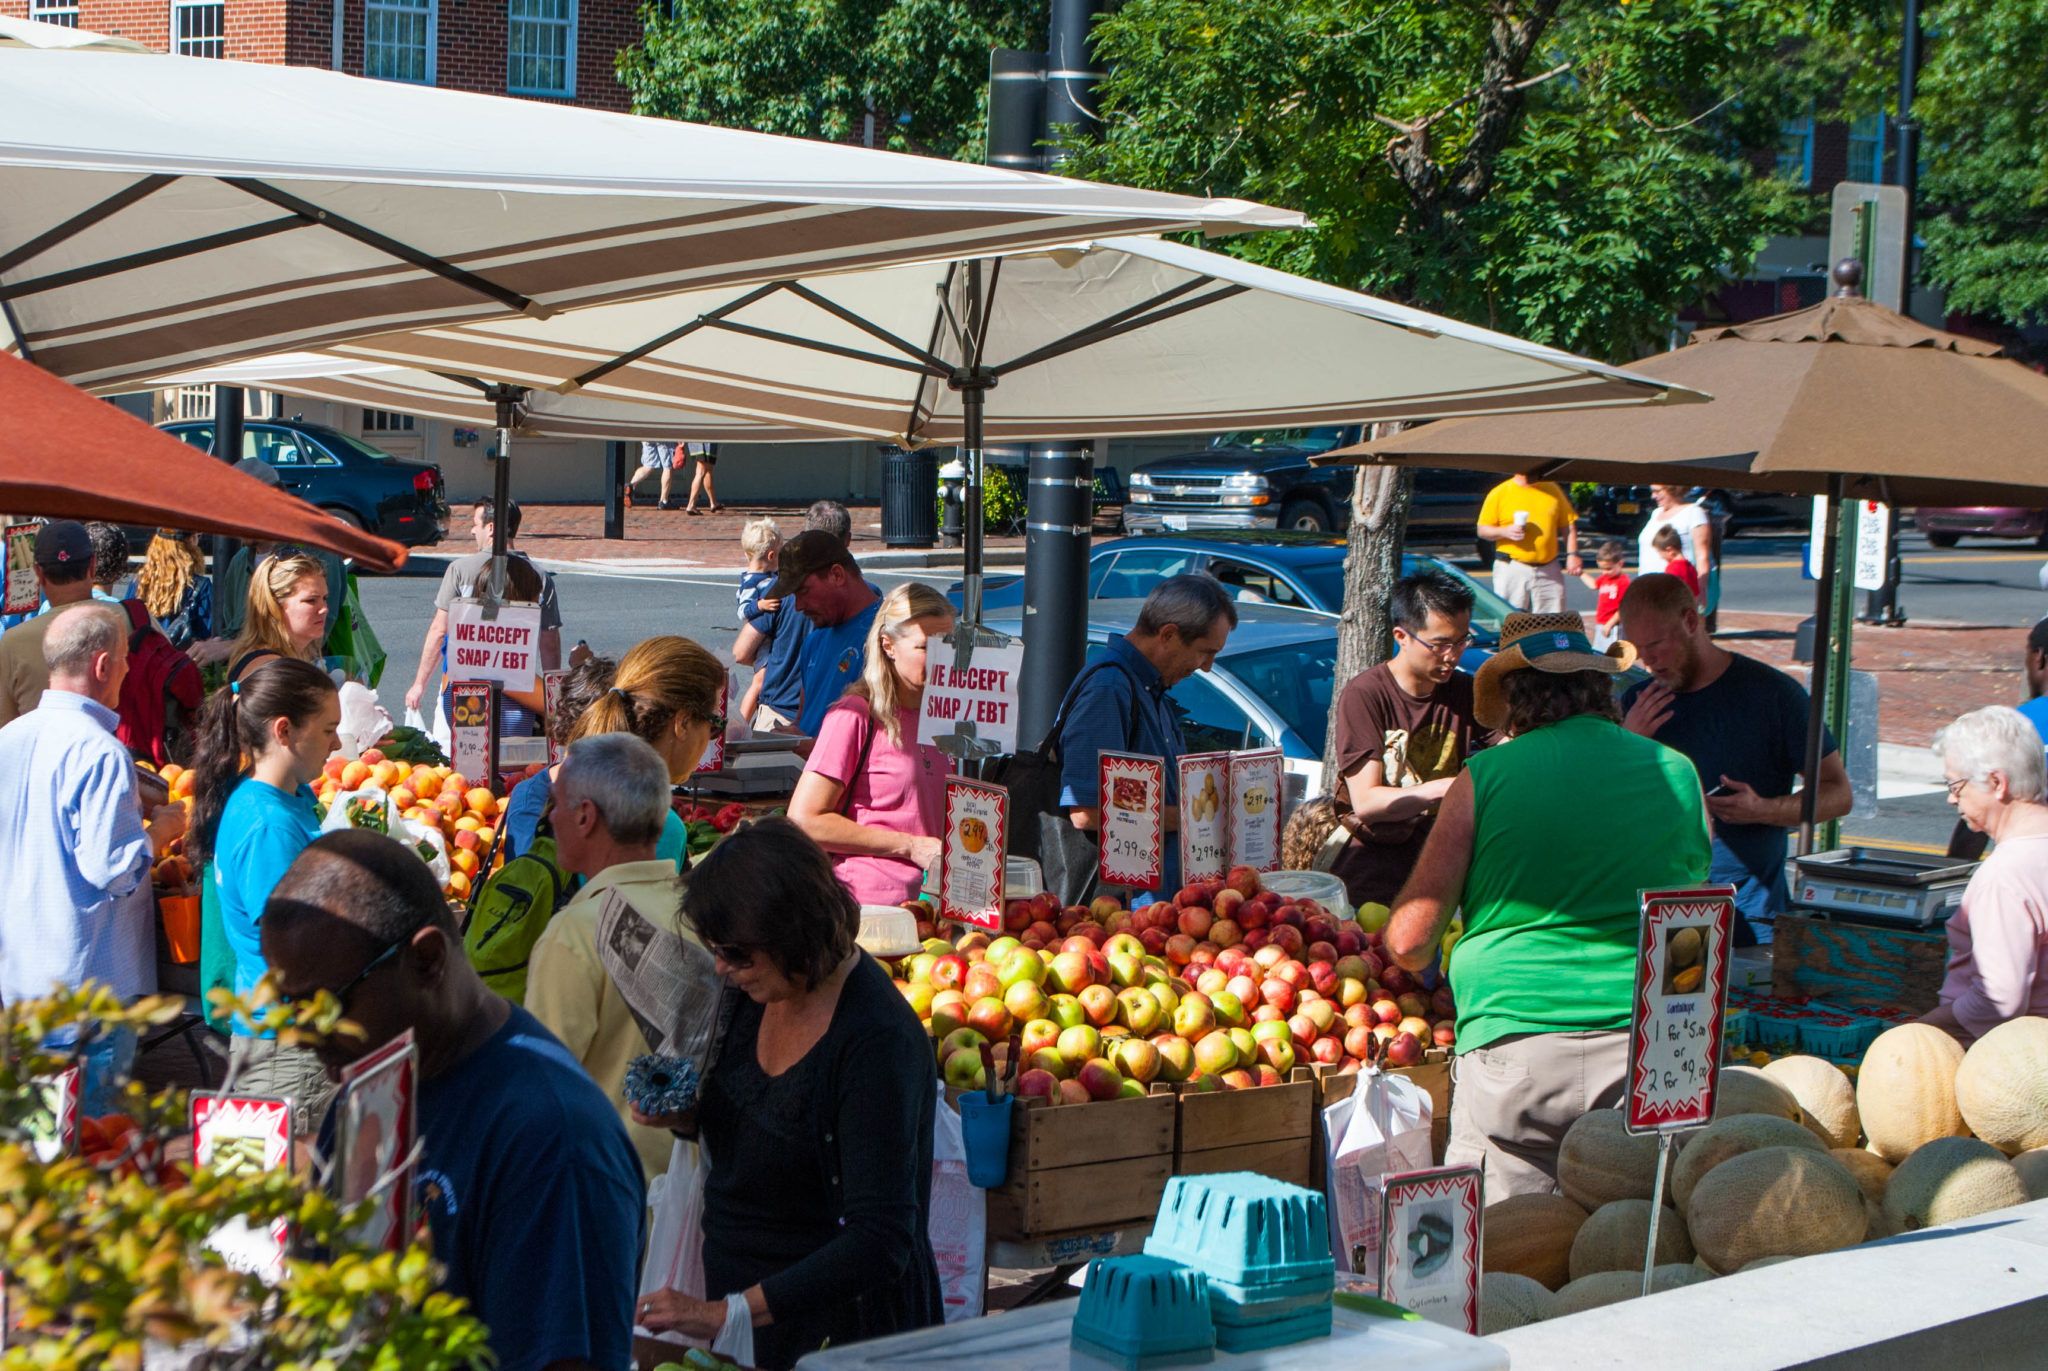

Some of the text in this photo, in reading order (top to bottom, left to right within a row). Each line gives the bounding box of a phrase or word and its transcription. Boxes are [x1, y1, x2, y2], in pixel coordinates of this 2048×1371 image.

[456, 623, 531, 646] WE ACCEPT
[457, 647, 529, 670] SNAP / EBT
[947, 665, 1010, 693] ACCEPT
[927, 694, 1009, 724] SNAP / EBT
[1655, 1018, 1706, 1042] 1 for $5.00
[1674, 1046, 1686, 1058] or
[1648, 1059, 1707, 1092] 2 for $9.00
